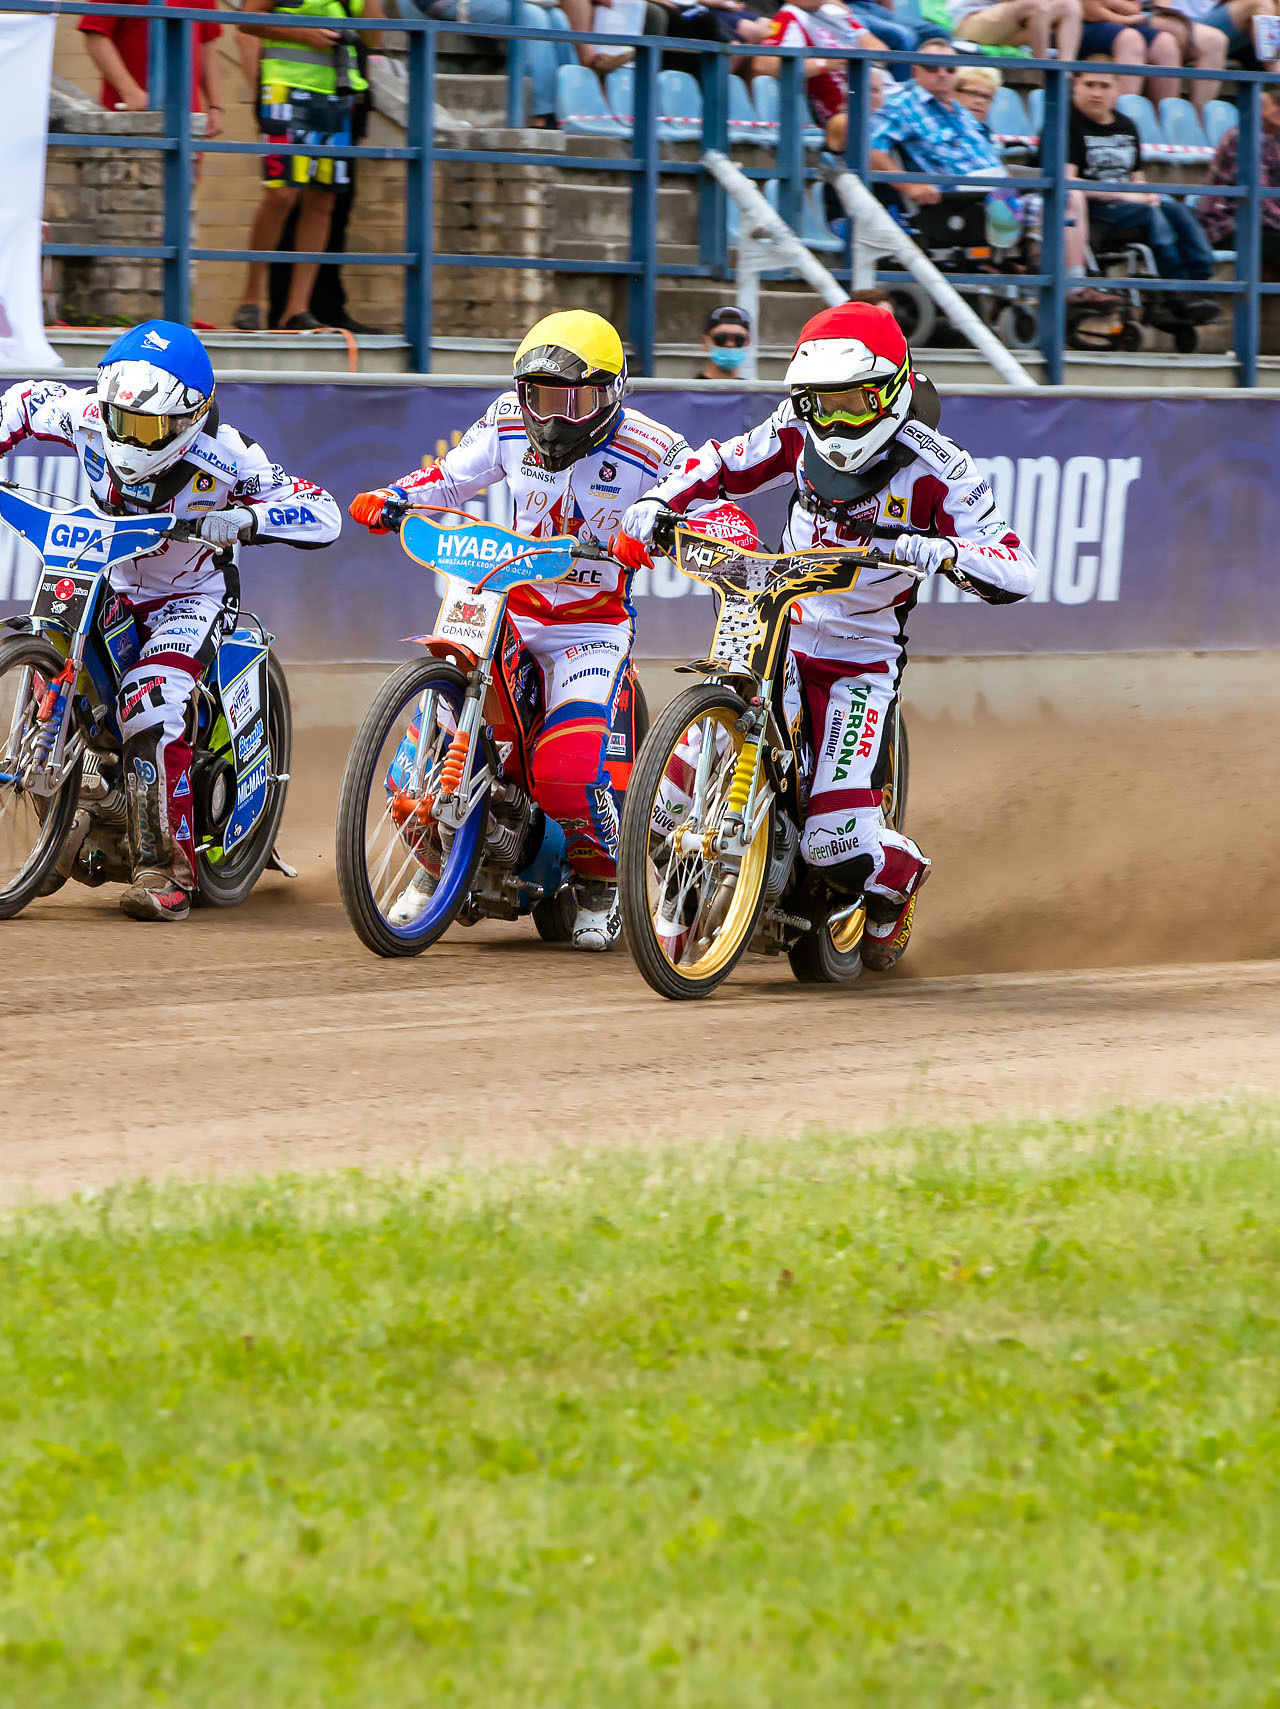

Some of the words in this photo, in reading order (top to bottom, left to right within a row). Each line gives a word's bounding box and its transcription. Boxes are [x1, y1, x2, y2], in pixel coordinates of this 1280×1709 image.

[525, 490, 548, 514] 19
[268, 506, 316, 526] GPA
[589, 507, 623, 531] 45
[51, 524, 104, 553] GPA
[436, 533, 535, 569] HYABAK
[476, 561, 499, 571] KROPL
[825, 709, 842, 760] ewinner
[832, 684, 872, 783] VERONA
[856, 708, 879, 759] BAR
[808, 836, 860, 862] GreenBūve
